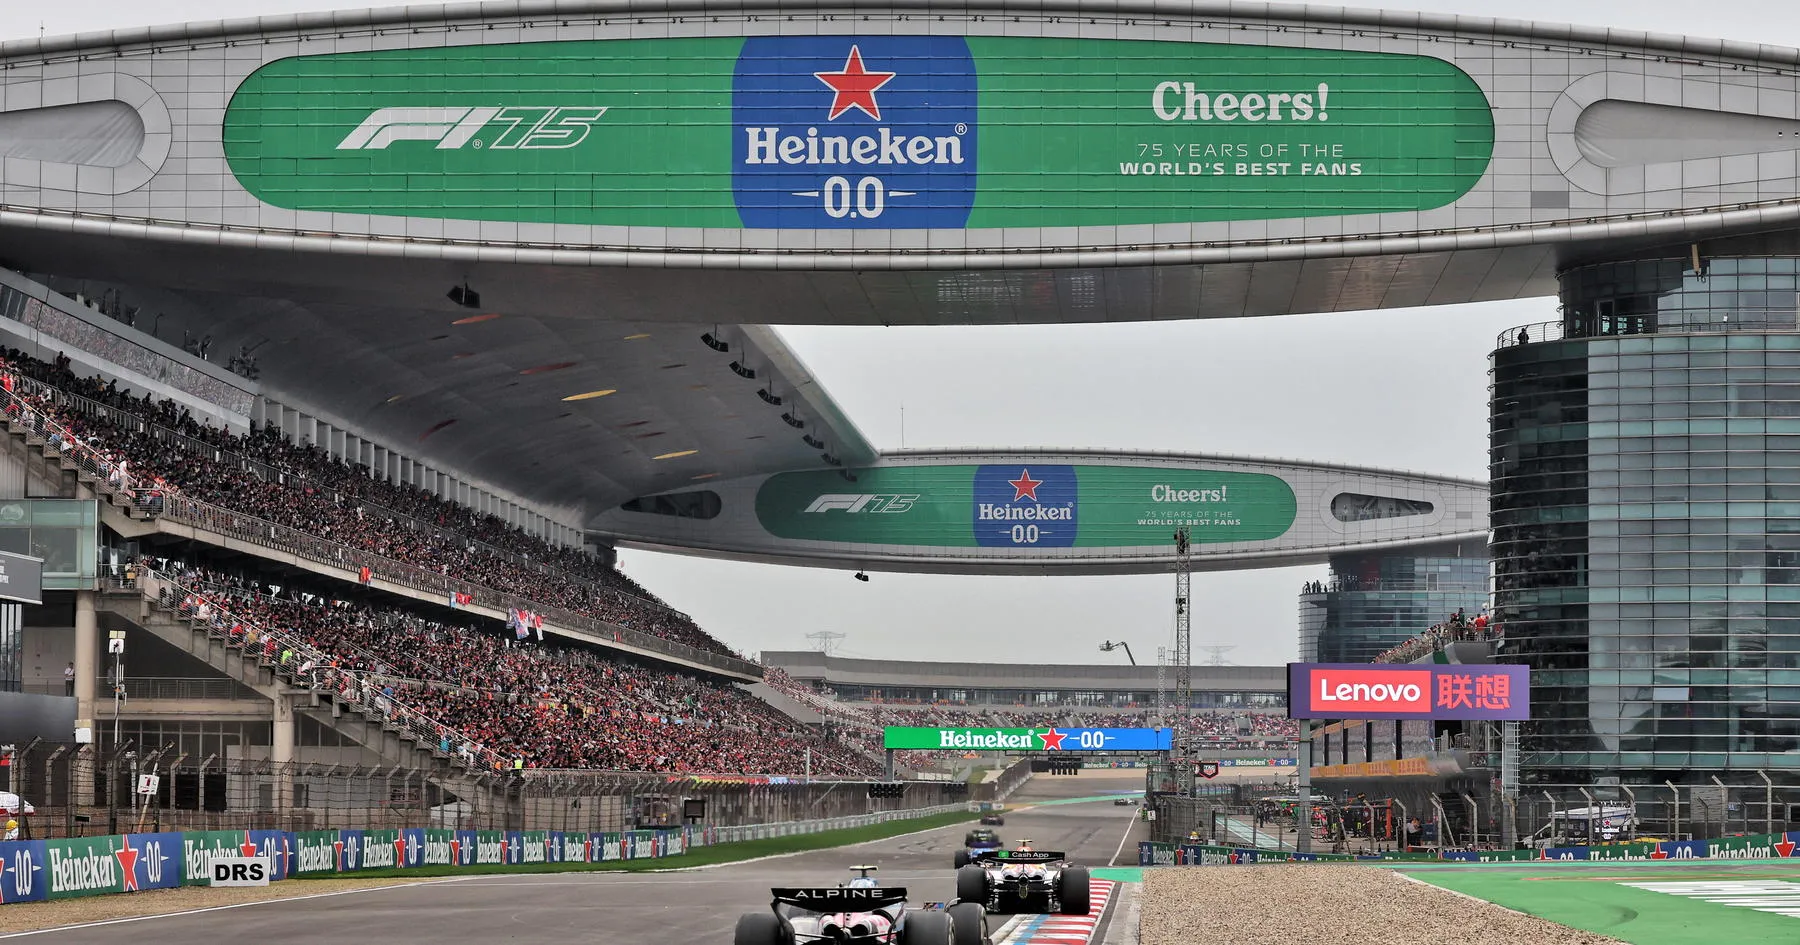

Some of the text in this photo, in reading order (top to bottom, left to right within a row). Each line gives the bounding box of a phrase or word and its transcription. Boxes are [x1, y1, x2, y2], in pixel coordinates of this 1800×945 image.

[1152, 81, 1329, 122] Cheers!
[745, 126, 965, 165] Heineken
[1137, 144, 1344, 157] 75 YEARS OF THE
[1119, 162, 1362, 176] WORLD'S BEST FANS
[824, 176, 884, 218] 0.0
[1151, 484, 1227, 502] Cheers!
[978, 503, 1073, 520] Heineken
[1012, 525, 1039, 543] 0.0
[1320, 678, 1421, 702] Lenovo
[1436, 674, 1511, 710] 联想
[939, 730, 1105, 748] Heineken 0.0
[49, 846, 116, 892] Heineken
[215, 863, 264, 881] DRS
[795, 889, 884, 899] ALPINE
